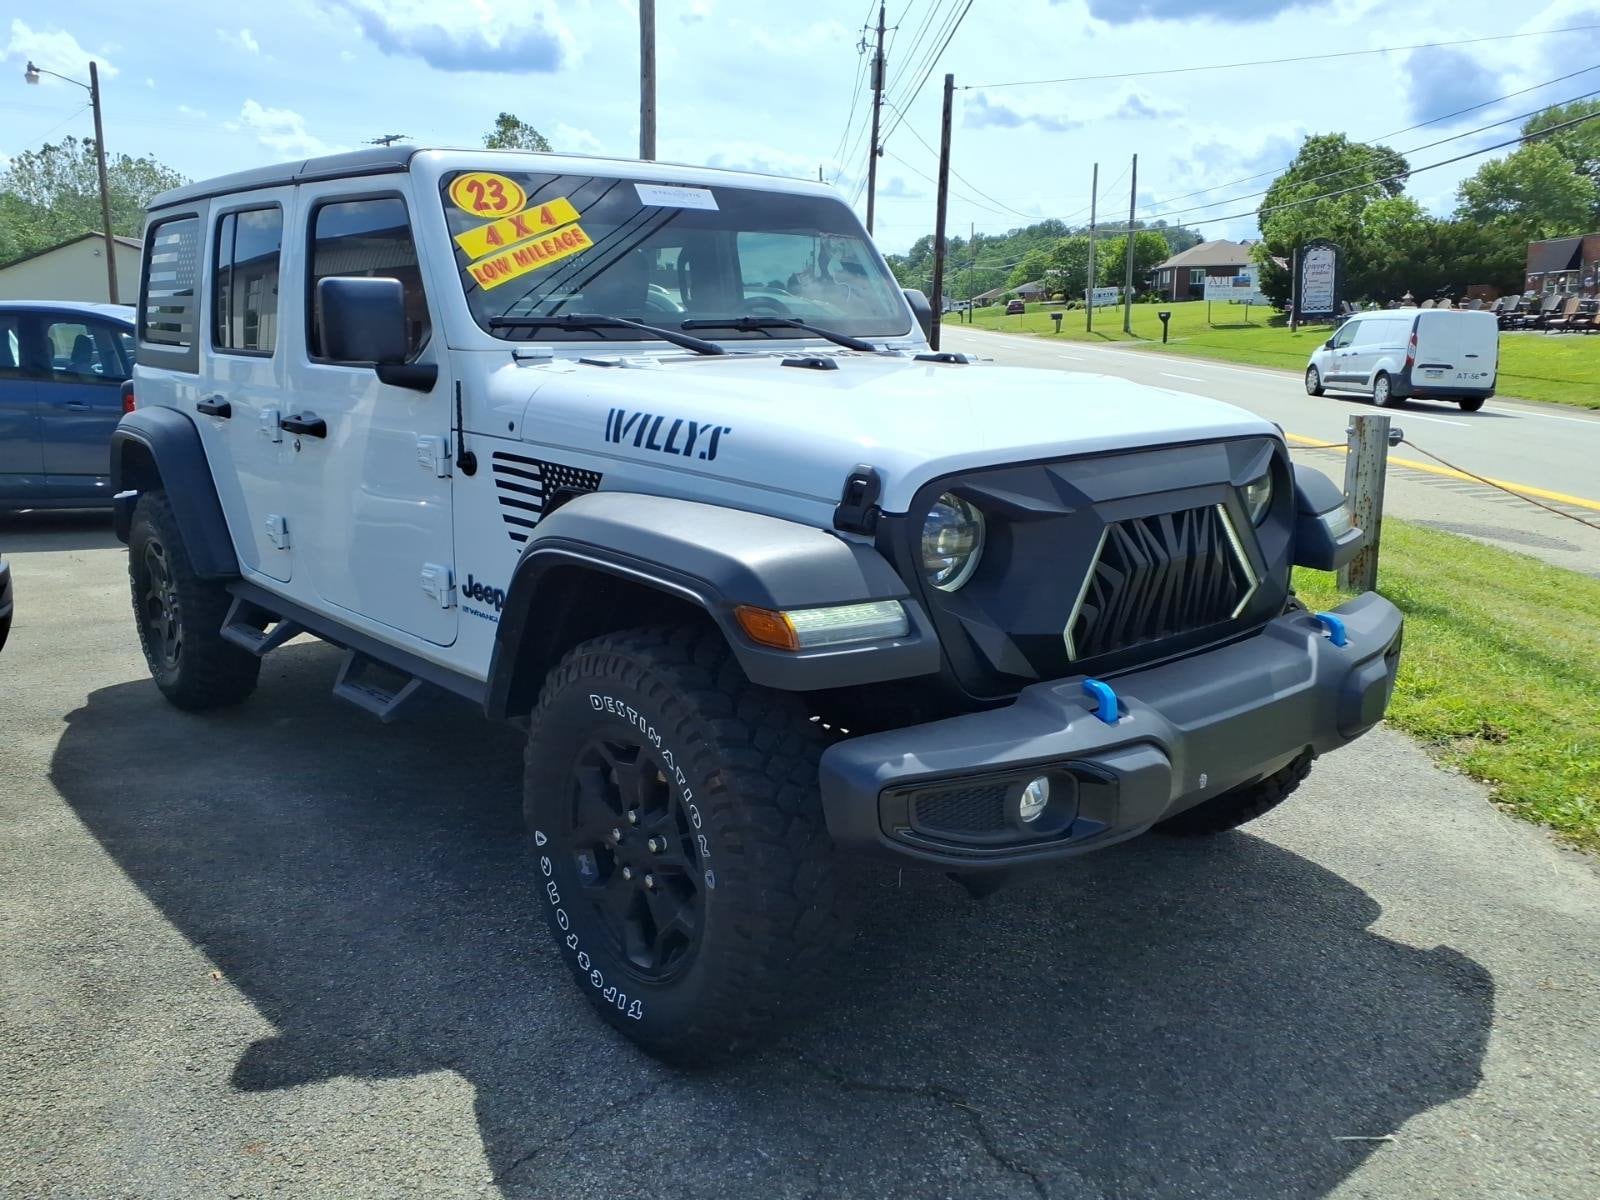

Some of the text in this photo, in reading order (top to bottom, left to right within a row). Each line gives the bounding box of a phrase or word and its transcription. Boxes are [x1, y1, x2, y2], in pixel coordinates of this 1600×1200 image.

[466, 178, 508, 211] 23
[485, 206, 557, 246] 4 X 4
[472, 228, 586, 284] LOW MILEAGE
[605, 408, 732, 461] WILLYS
[462, 573, 506, 612] Jeep
[589, 694, 711, 857] DESTINATION
